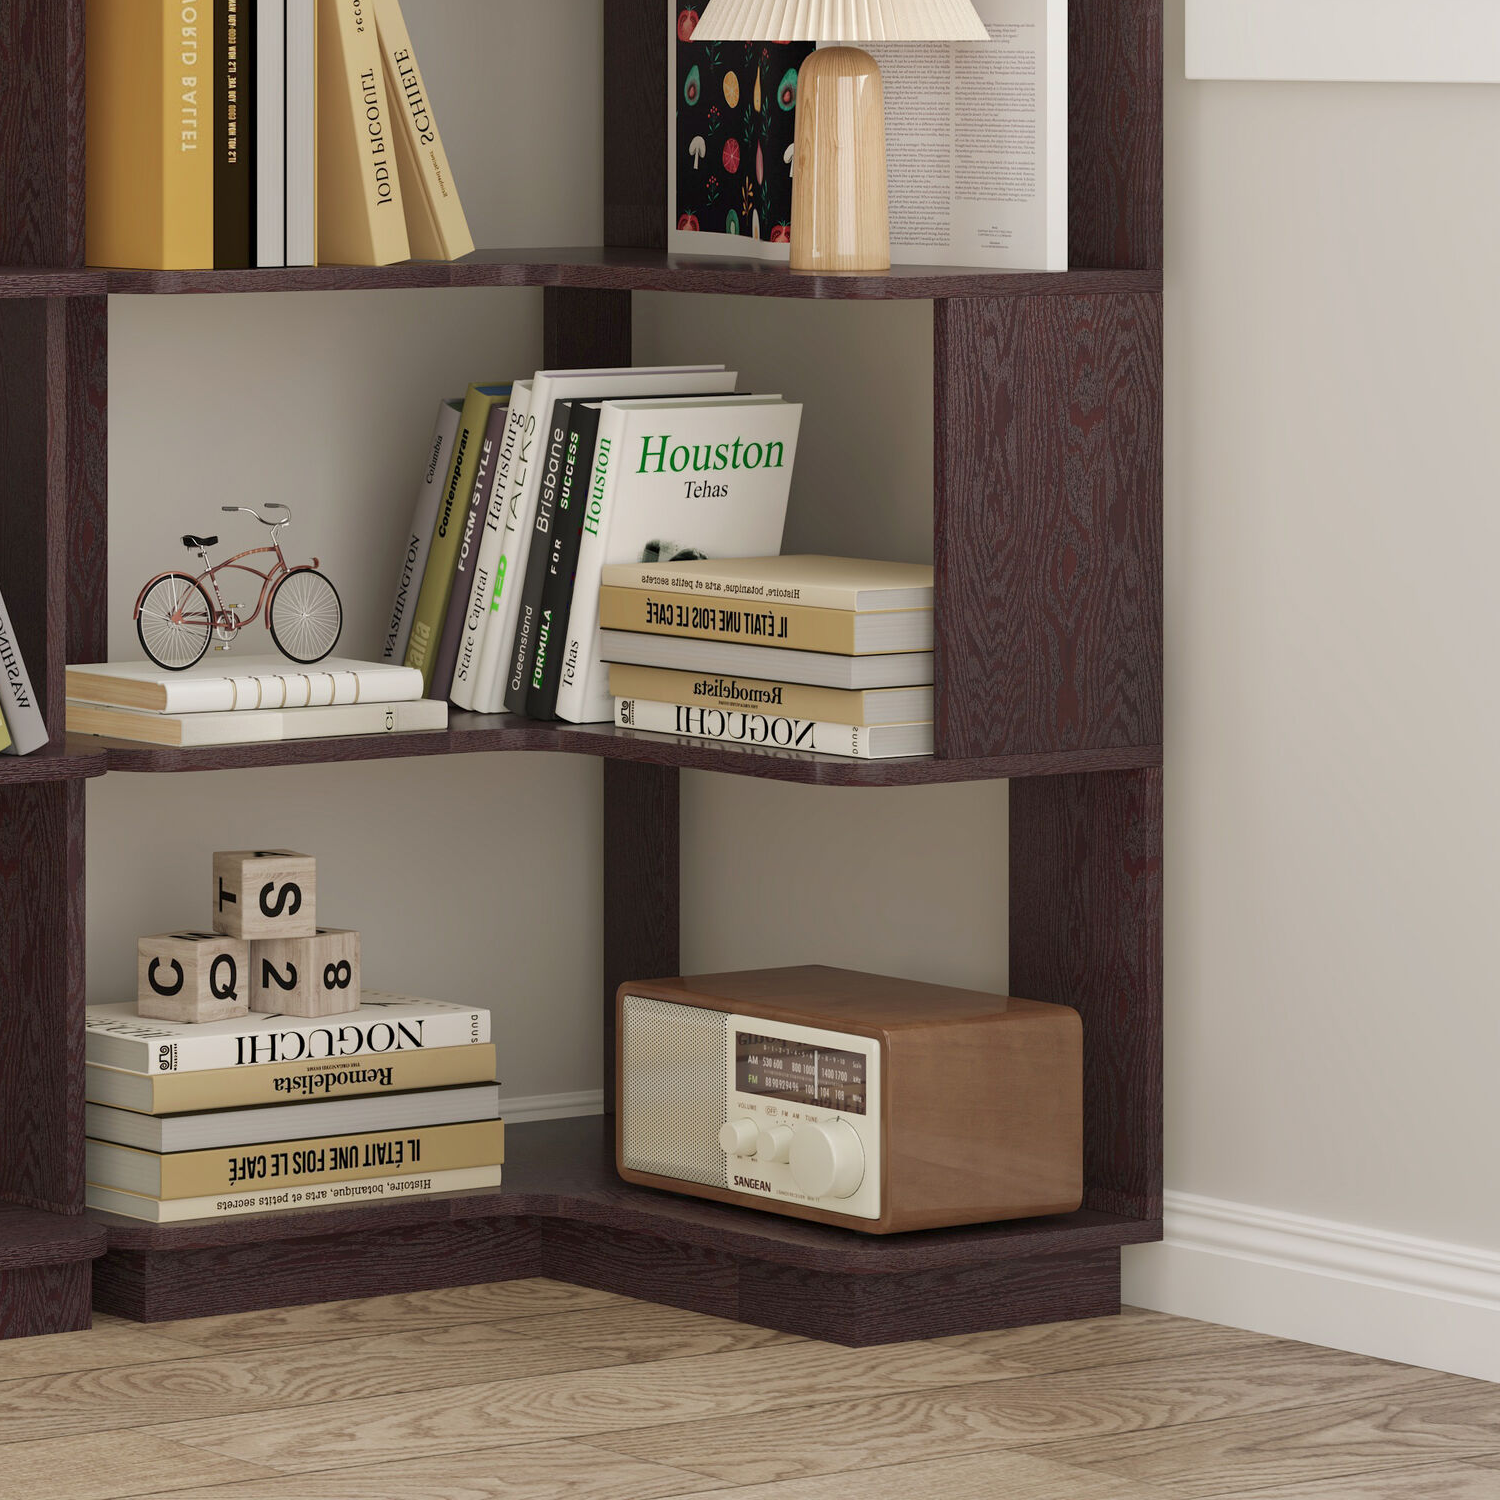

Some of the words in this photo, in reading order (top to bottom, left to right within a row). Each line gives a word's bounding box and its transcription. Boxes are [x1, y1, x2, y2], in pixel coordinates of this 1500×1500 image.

[438, 428, 470, 538] Contemporan
[535, 427, 564, 534] Brisbane
[635, 434, 785, 474] Houston
[457, 513, 477, 572] FORM
[472, 438, 493, 505] STYLE
[684, 481, 729, 499] Tehas
[532, 609, 553, 690] FORMULA
[550, 538, 562, 575] FOR
[560, 431, 580, 510] SUCCESS
[562, 639, 579, 689] Tehas
[584, 436, 612, 538] Houston
[384, 534, 420, 659] WASHINGTON
[511, 605, 533, 692] Queensland
[234, 1018, 426, 1067] NOGUCHI
[748, 1055, 758, 1065] AM
[273, 1066, 394, 1095] Remodelista
[748, 1074, 758, 1084] FM
[734, 1175, 771, 1193] SANGEAN
